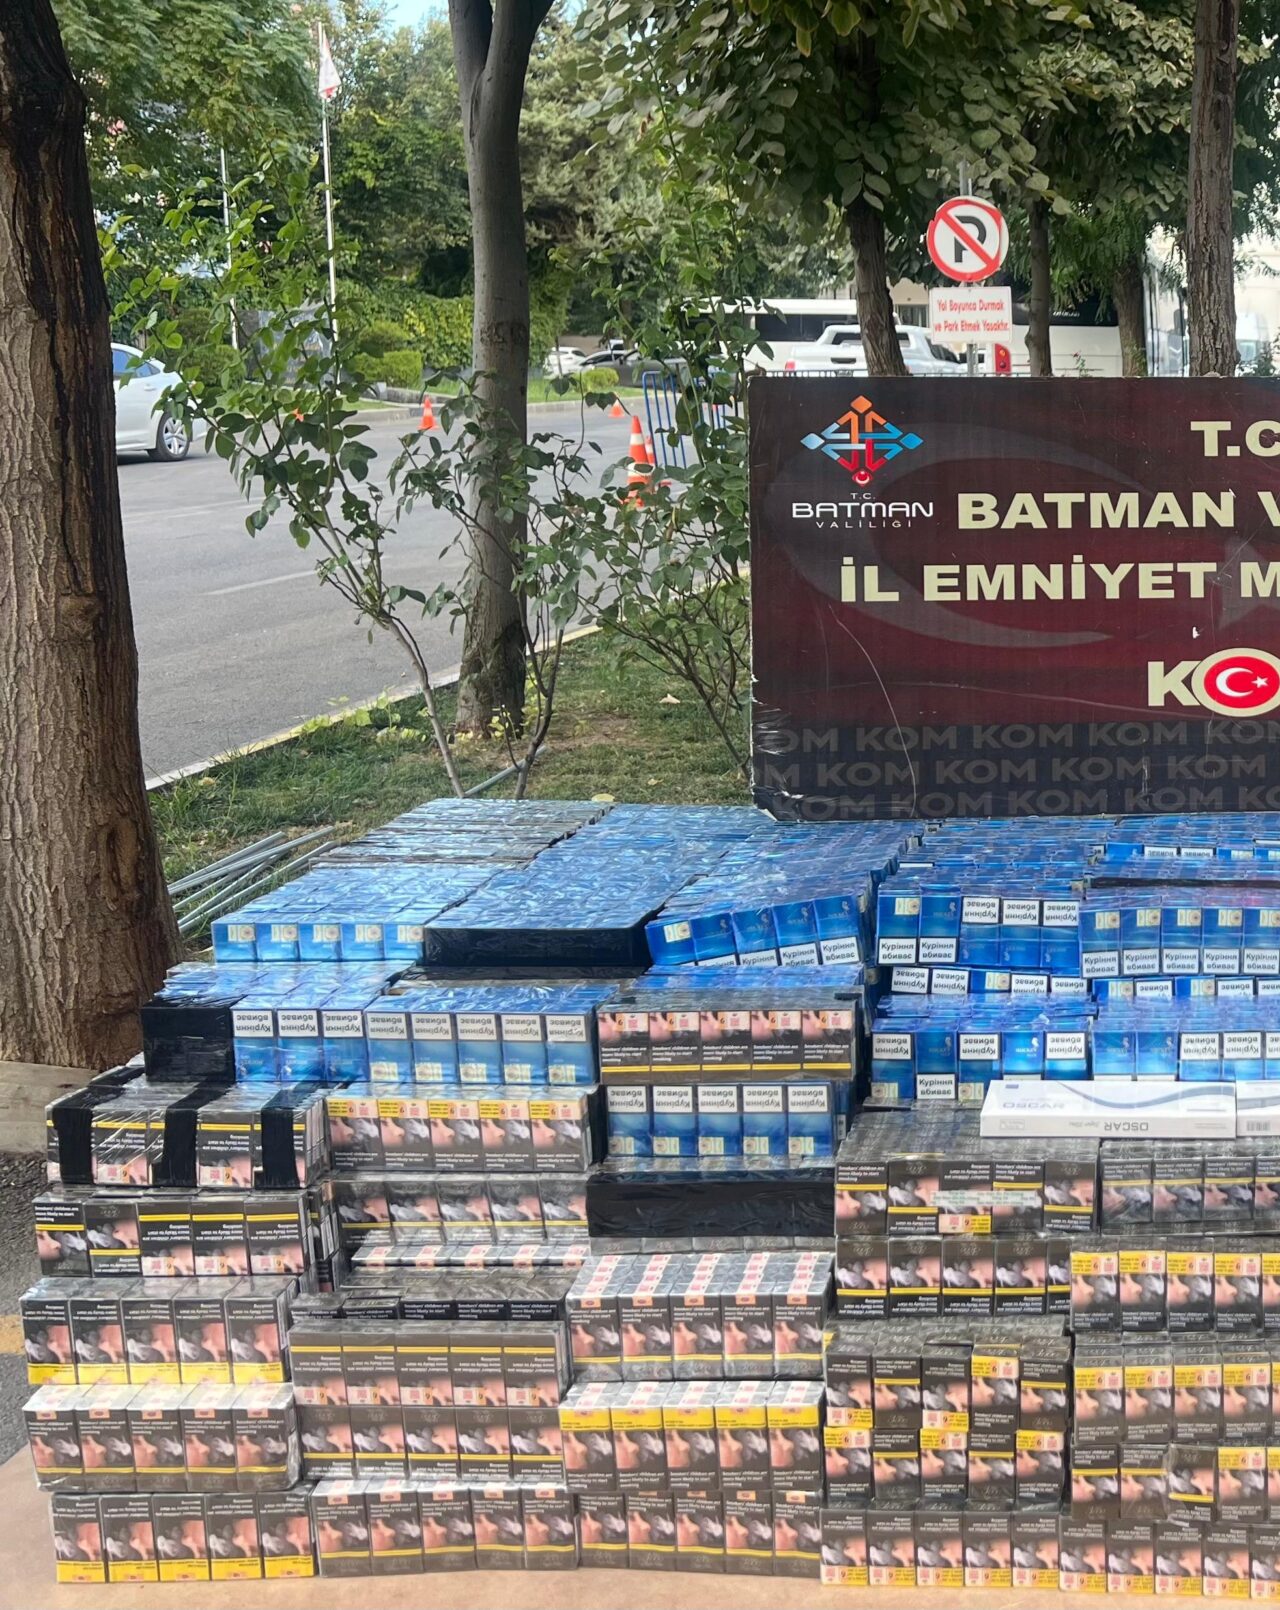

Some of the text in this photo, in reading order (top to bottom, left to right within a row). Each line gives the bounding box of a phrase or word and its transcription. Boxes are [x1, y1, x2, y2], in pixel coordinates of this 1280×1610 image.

[937, 299, 1004, 315] Yol Boyunca Durmak
[934, 323, 942, 331] ve
[944, 320, 958, 331] Park
[961, 320, 980, 331] Etmek
[851, 492, 875, 500] T.C.
[791, 501, 934, 519] BATMAN
[957, 491, 1236, 529] BATMAN
[815, 518, 913, 529] VALİLİĞİ
[840, 556, 899, 603] İL
[923, 554, 1217, 601] EMNİYET
[856, 726, 957, 751] KOM
[973, 723, 1073, 749] KOM
[1089, 721, 1187, 746] KOM
[817, 762, 919, 788] KOM
[936, 759, 1036, 785] KOM
[1052, 756, 1150, 782] KOM
[1168, 754, 1265, 780] KOM
[891, 791, 993, 817] KOM
[1008, 789, 1107, 815] KOM
[1125, 786, 1223, 812] KOM
[1104, 1121, 1149, 1131] OSCAR
